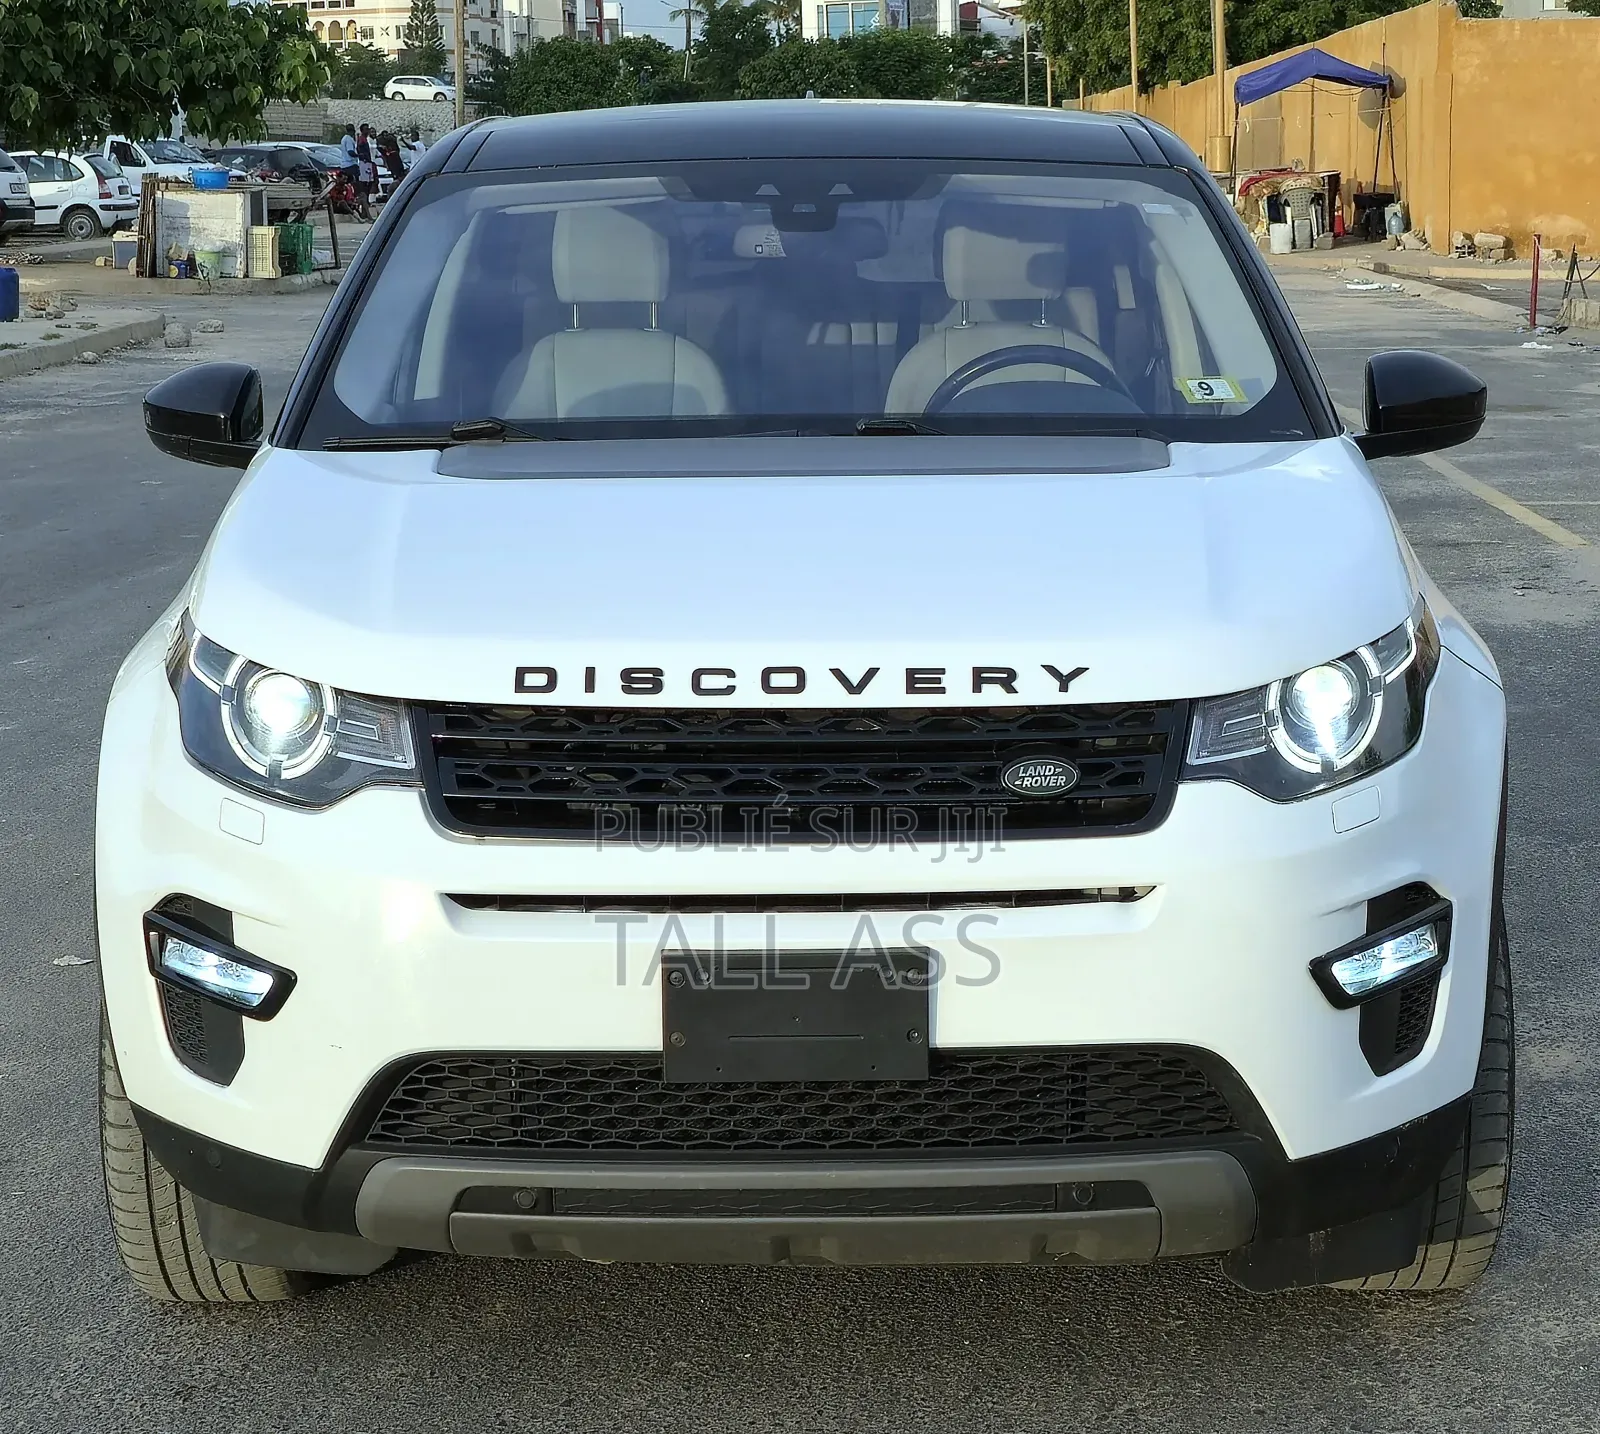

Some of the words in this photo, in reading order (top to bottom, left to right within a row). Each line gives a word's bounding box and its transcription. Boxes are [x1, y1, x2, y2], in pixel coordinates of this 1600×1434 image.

[514, 664, 1090, 695] DISCOVERY
[1019, 765, 1055, 777] LAND
[1022, 775, 1066, 788] ROVER
